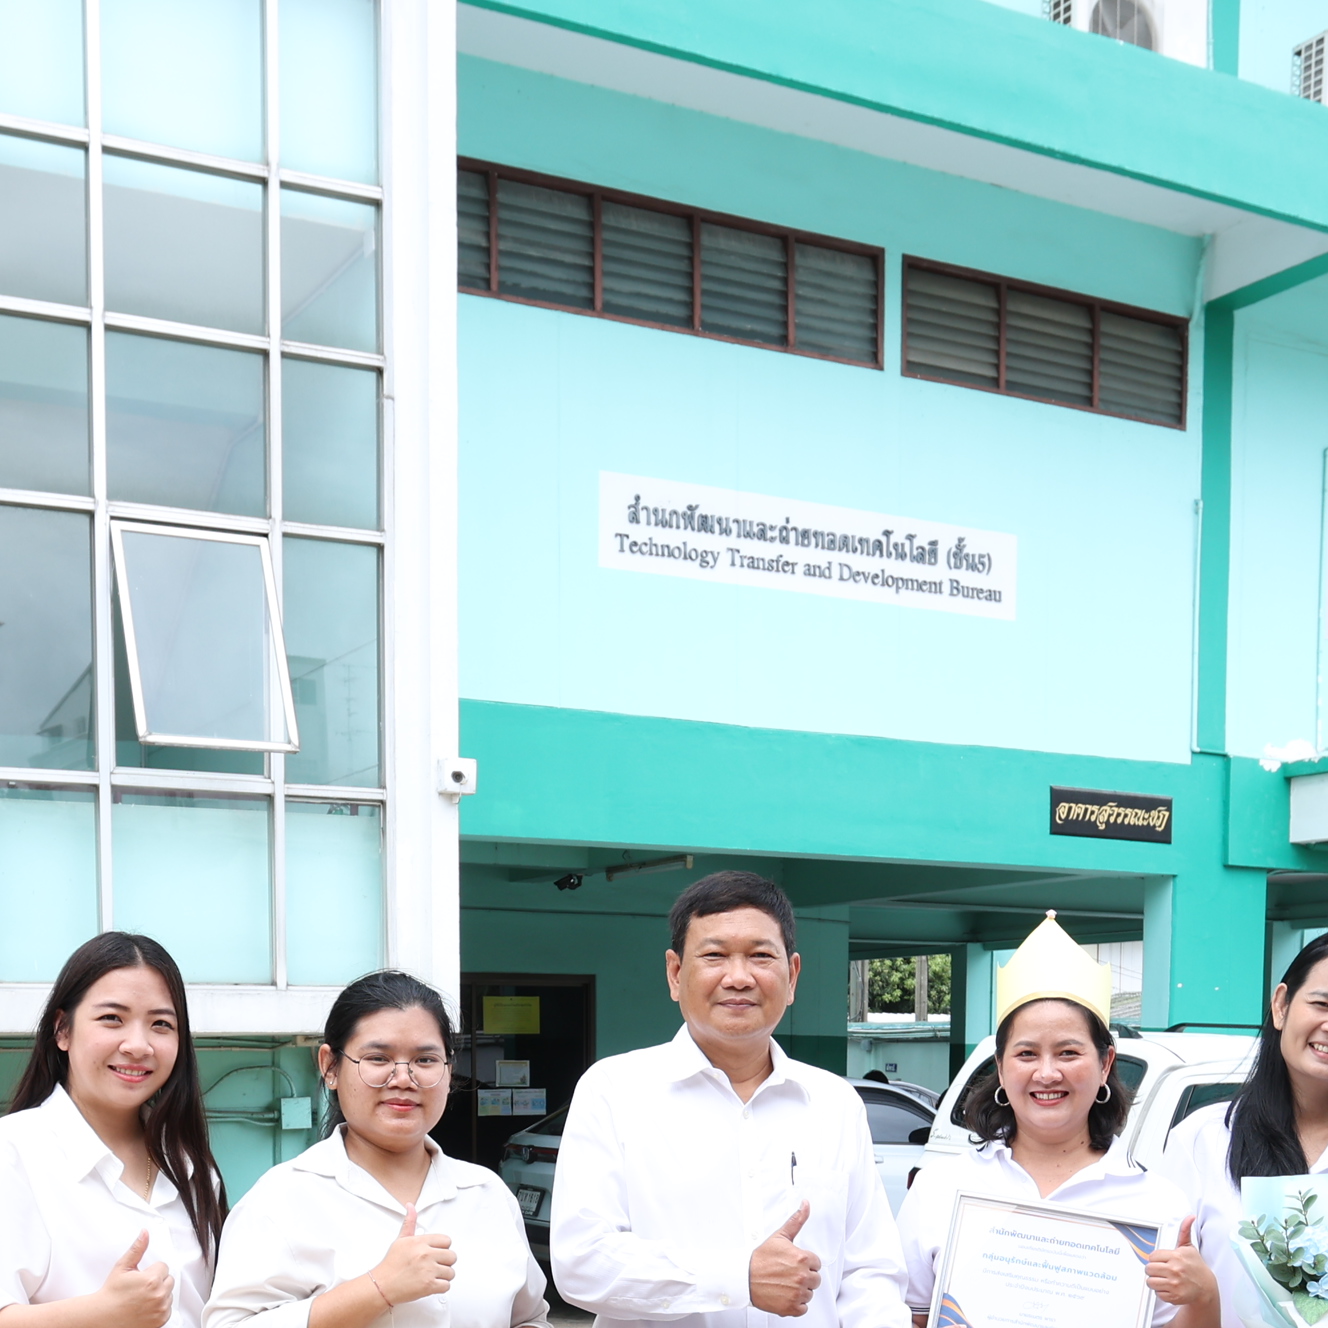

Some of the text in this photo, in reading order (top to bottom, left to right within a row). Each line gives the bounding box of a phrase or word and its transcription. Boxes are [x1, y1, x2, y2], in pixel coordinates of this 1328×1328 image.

[615, 532, 1002, 603] Technology Transfer and Development Bureau
[988, 1226, 1121, 1256] สำนักพัฒนาและถ่ายทอดเทคโนโลยี
[982, 1251, 1118, 1282] กลุ่มอนุรักษ์และฟื้นฟูสภาพแวดล้อม
